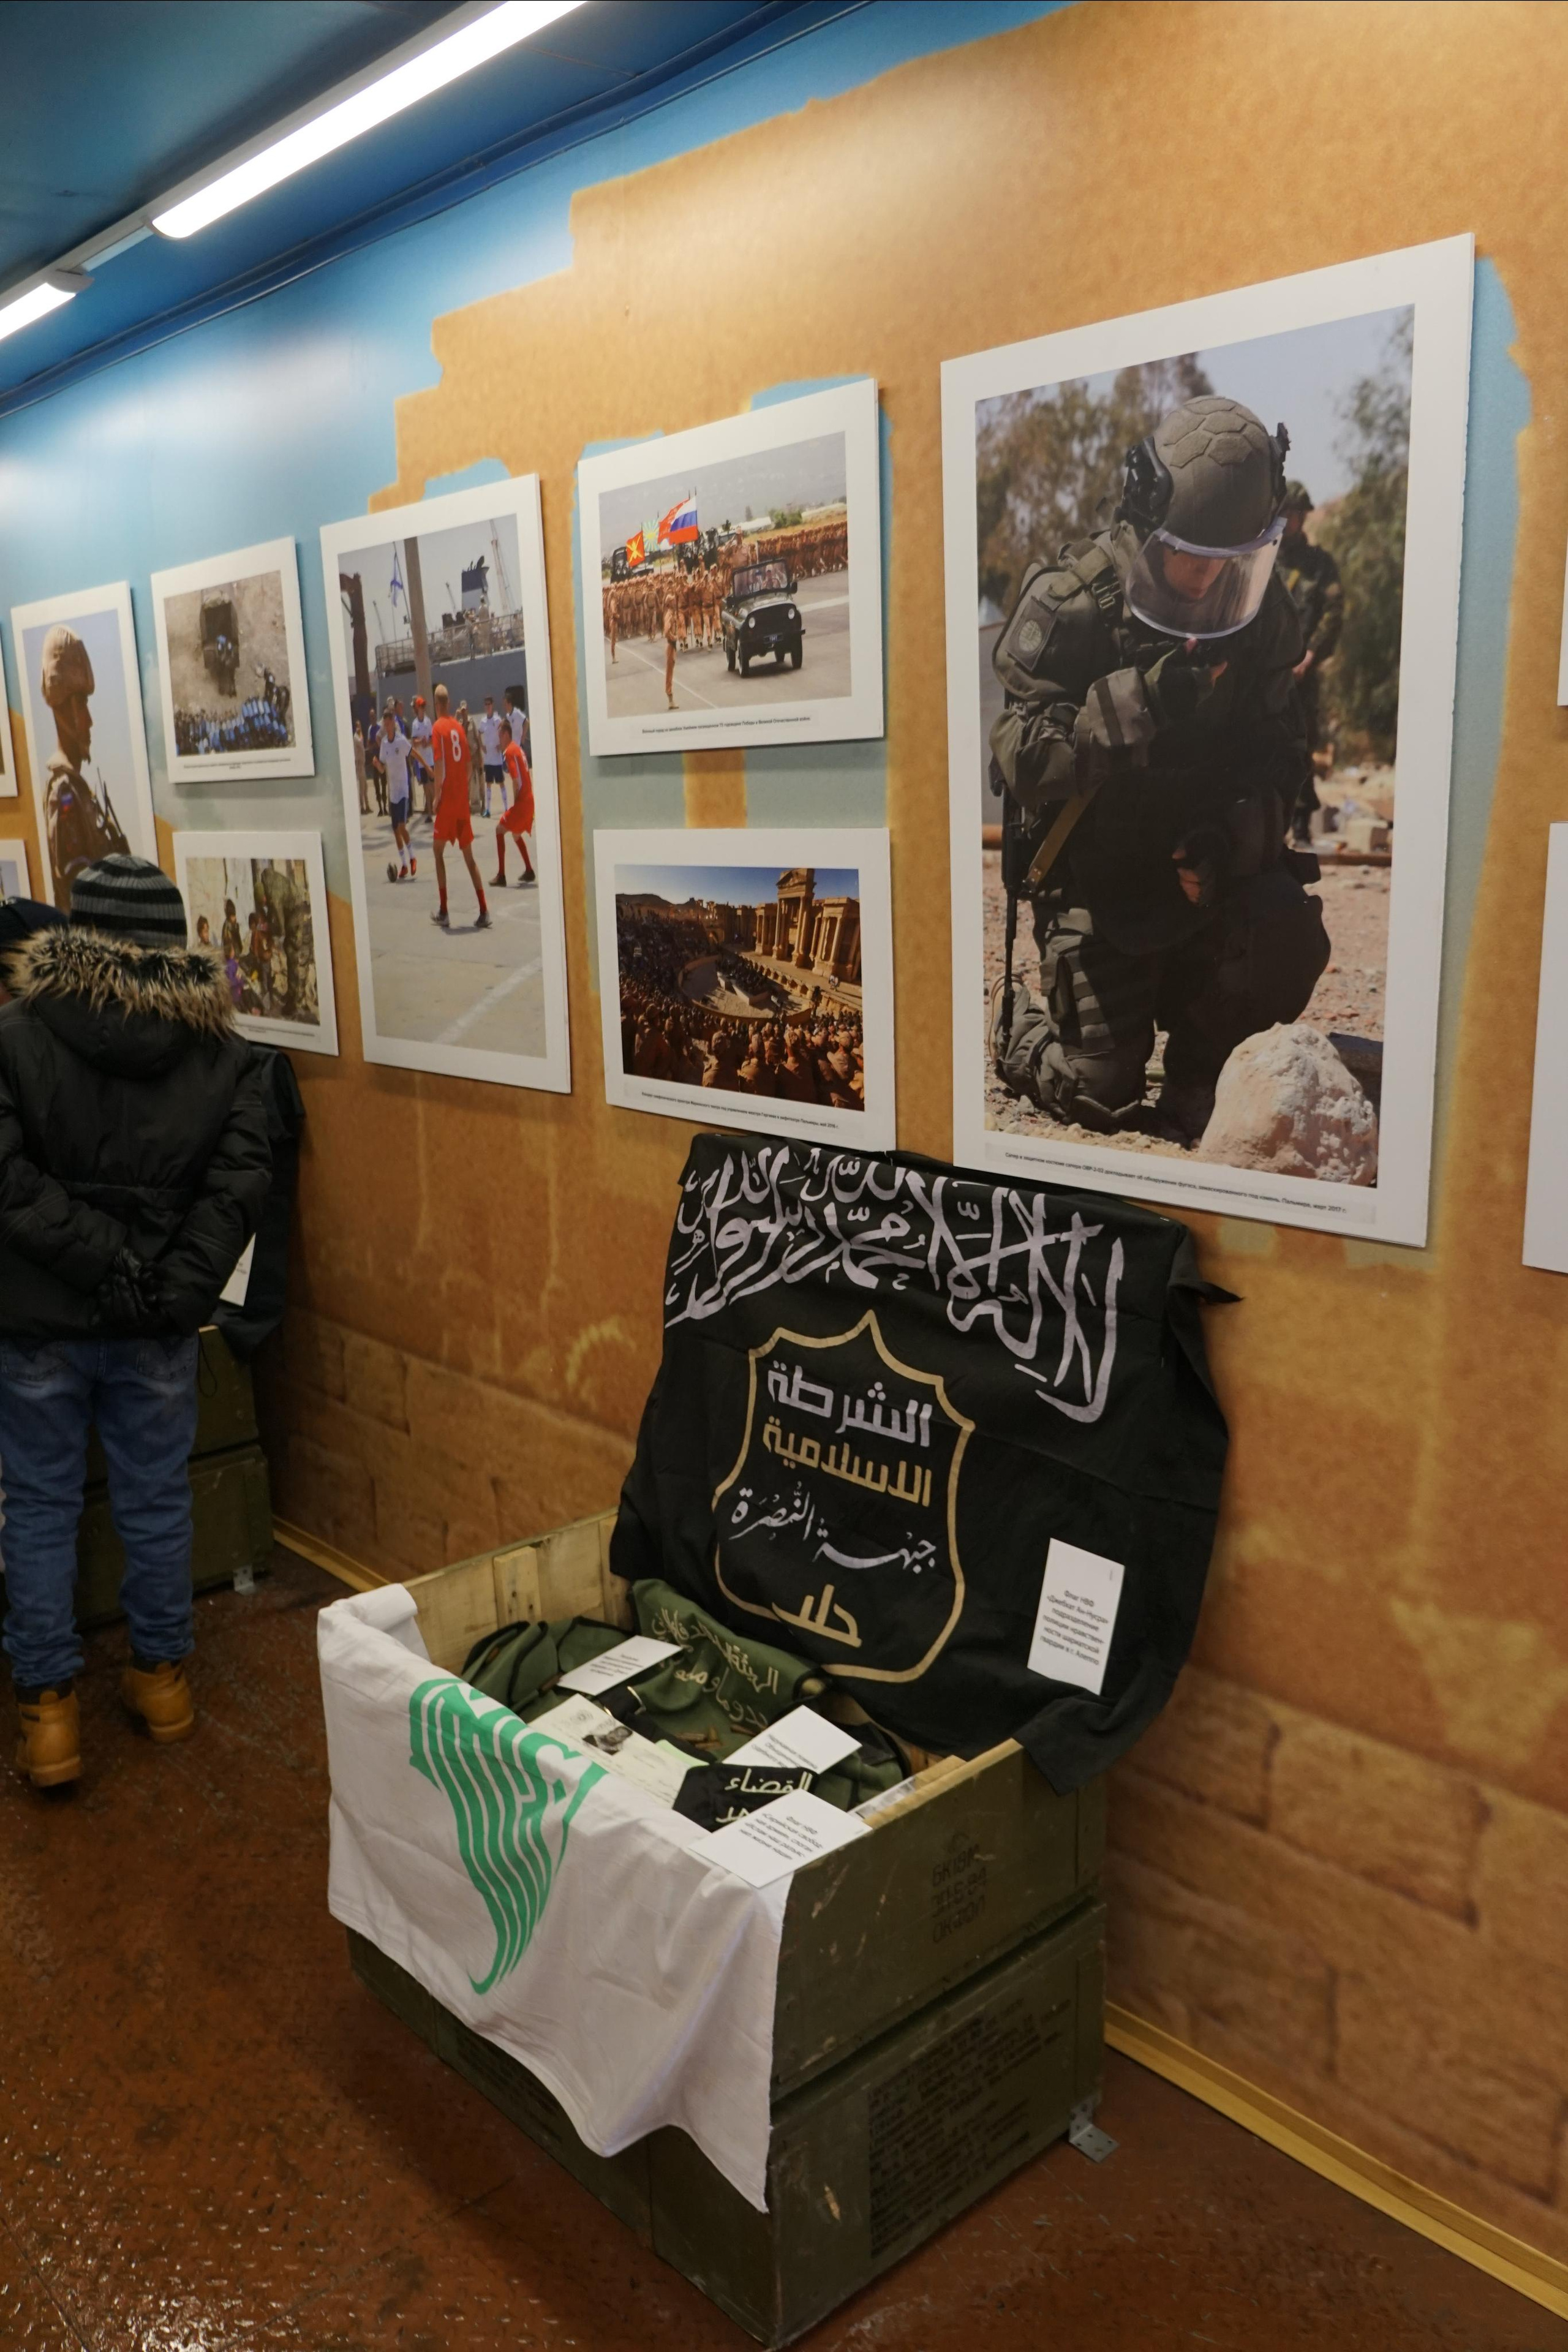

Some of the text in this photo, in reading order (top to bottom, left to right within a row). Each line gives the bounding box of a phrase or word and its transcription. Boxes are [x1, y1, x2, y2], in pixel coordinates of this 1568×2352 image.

[450, 730, 462, 762] 8
[767, 1360, 932, 1447] الشرطة
[772, 1583, 862, 1648] حلب
[1064, 1590, 1079, 1600] Флаг
